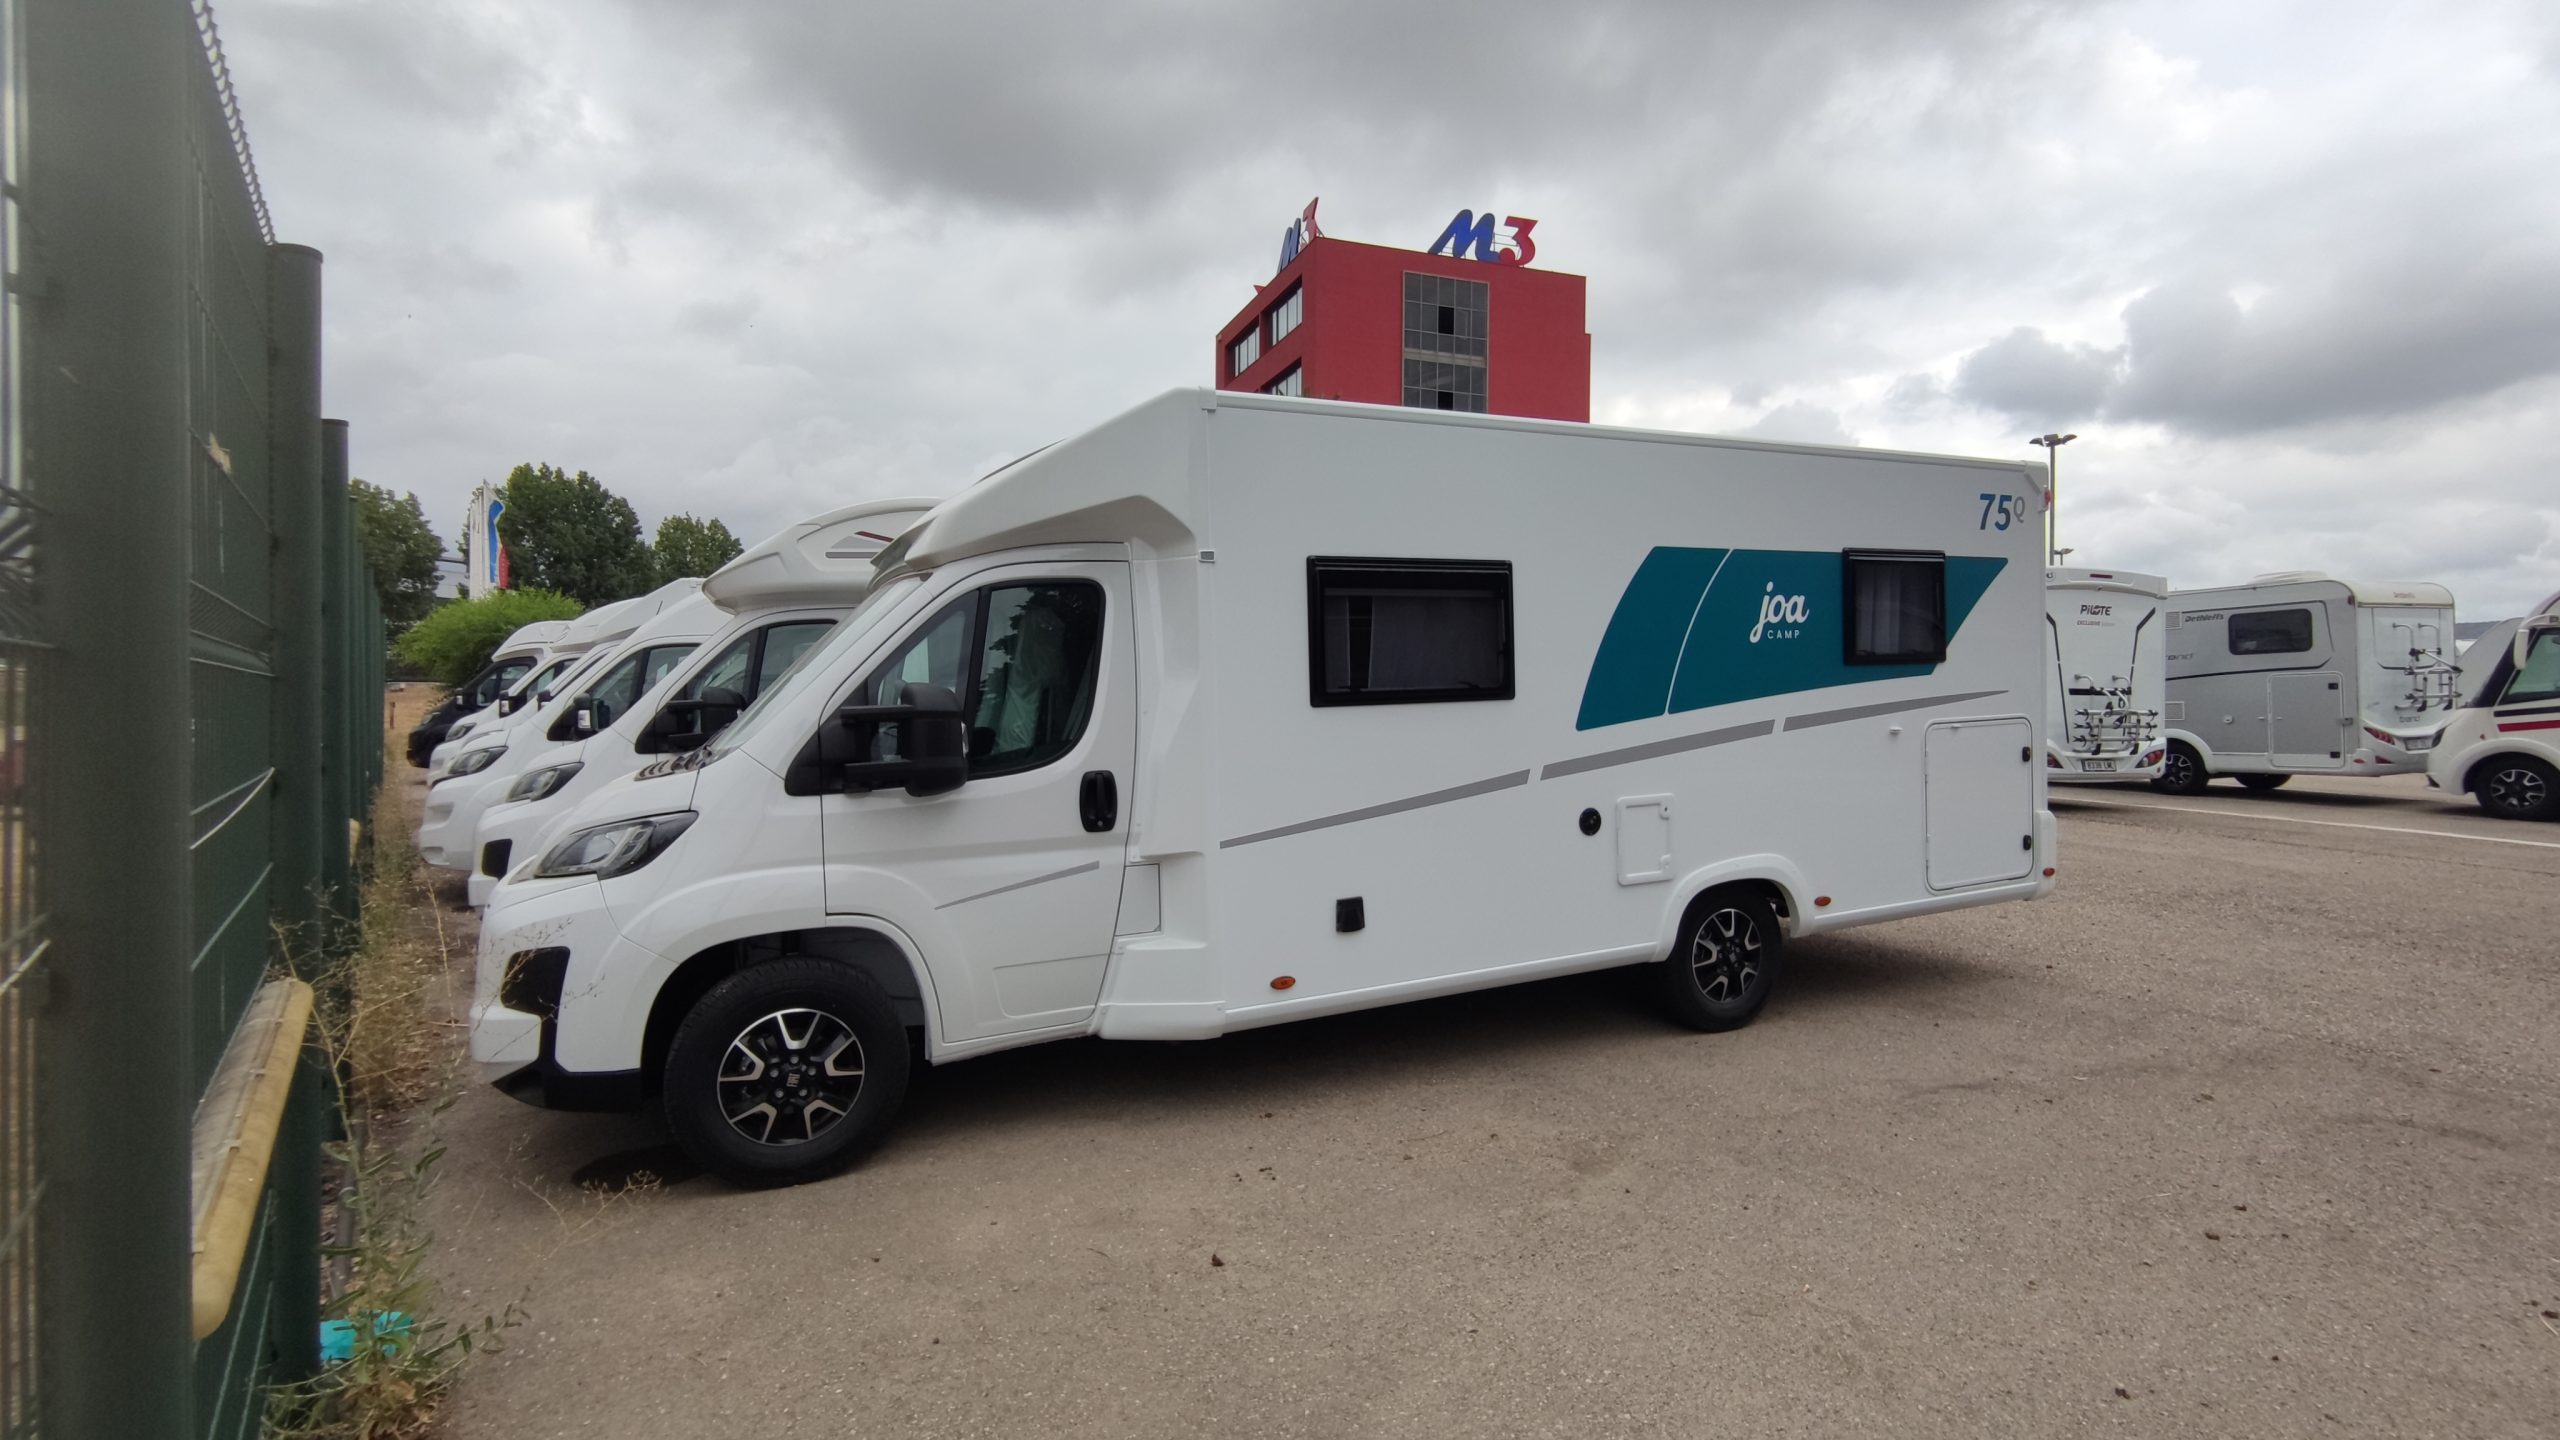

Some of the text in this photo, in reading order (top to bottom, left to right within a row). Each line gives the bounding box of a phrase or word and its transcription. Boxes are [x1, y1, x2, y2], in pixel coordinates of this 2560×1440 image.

[1427, 208, 1539, 267] M3
[1749, 581, 1810, 643] joa
[1766, 629, 1800, 640] CAMP
